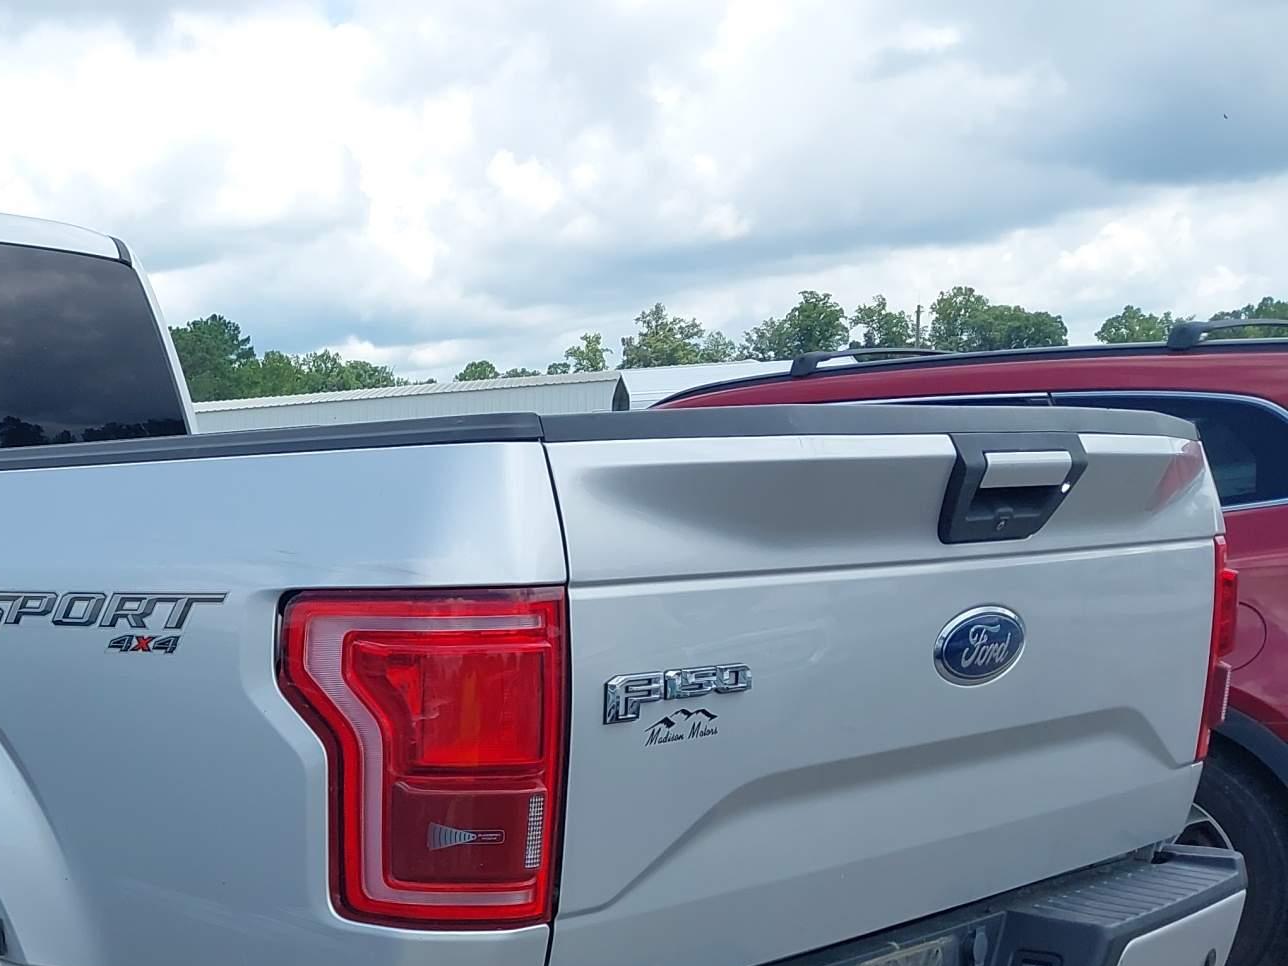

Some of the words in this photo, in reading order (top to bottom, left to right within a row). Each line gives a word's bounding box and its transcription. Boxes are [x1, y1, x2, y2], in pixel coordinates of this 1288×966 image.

[961, 624, 1012, 668] Ford
[644, 727, 685, 747] Madison
[687, 720, 719, 740] Motors
